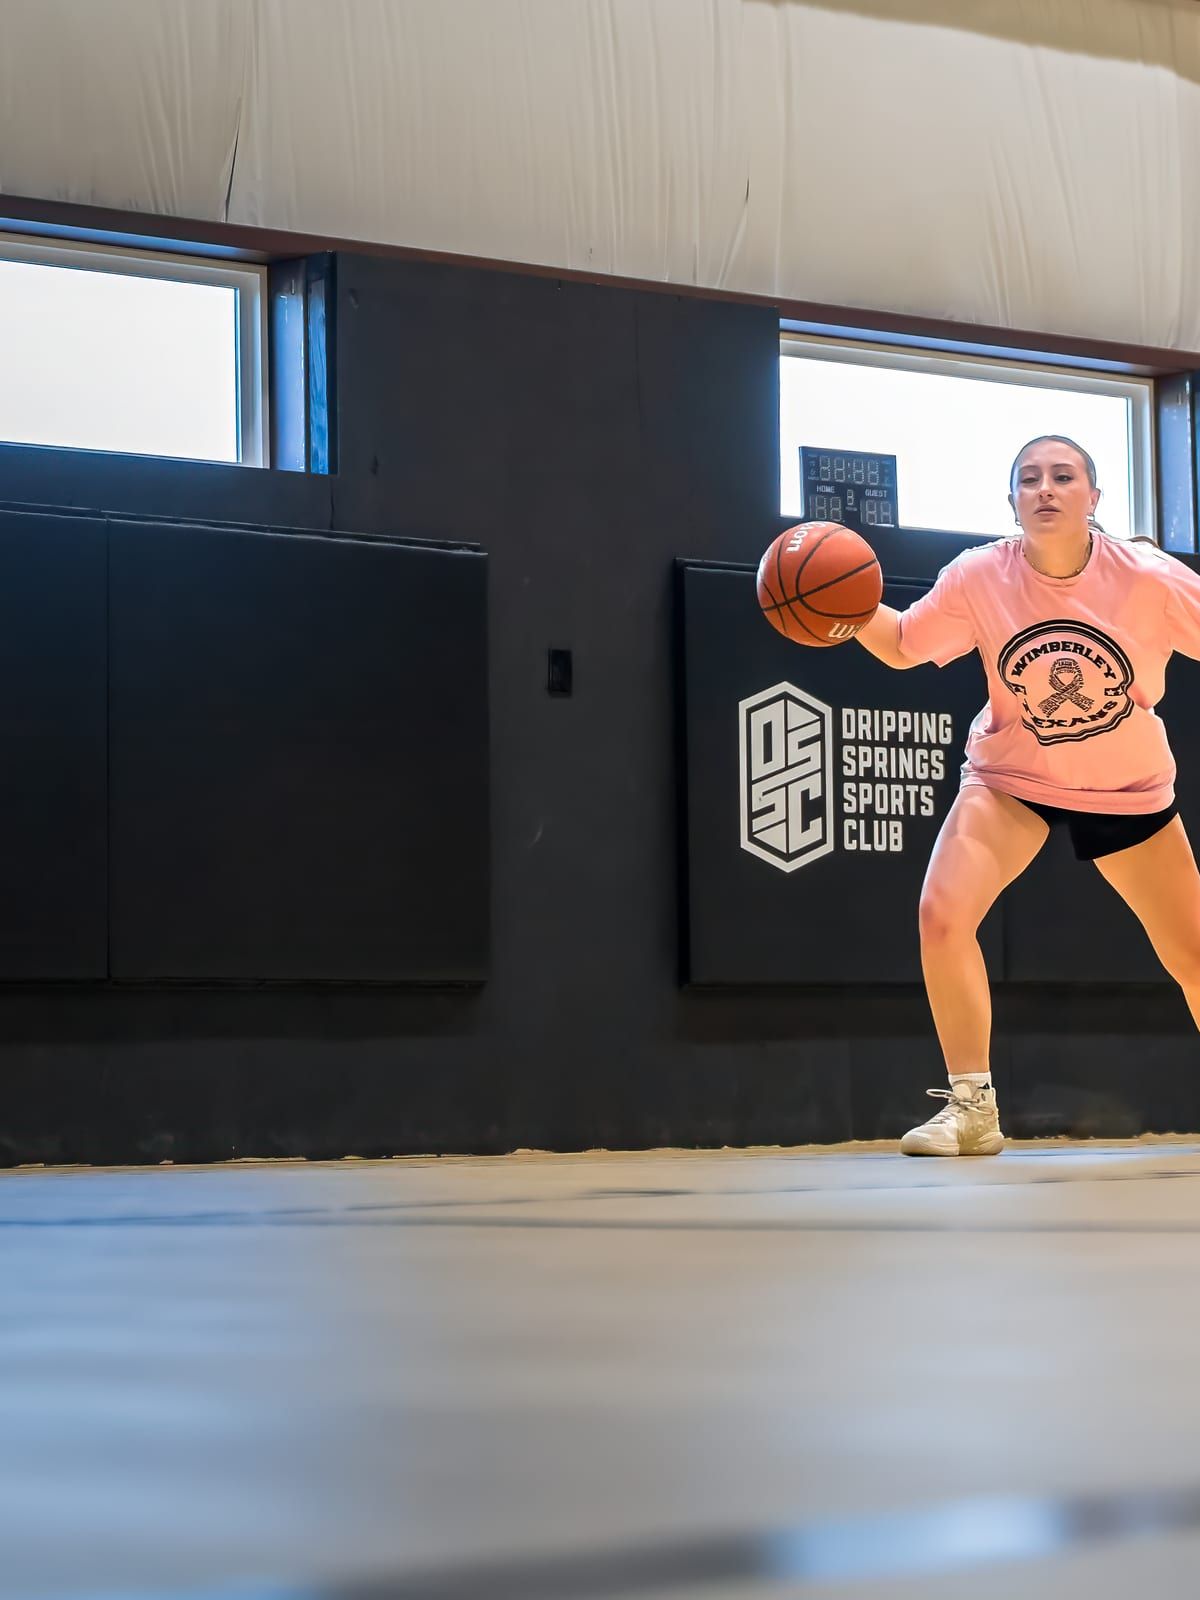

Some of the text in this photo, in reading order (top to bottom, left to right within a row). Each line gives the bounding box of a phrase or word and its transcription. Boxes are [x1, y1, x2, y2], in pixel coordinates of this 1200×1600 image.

[816, 485, 836, 494] HOME
[864, 488, 888, 498] GUEST
[1011, 641, 1117, 680] WIMBERLEY
[841, 707, 953, 745] DRIPPING
[842, 745, 945, 781] SPRINGS
[843, 782, 935, 817] SPORTS
[843, 819, 904, 853] CLUB
